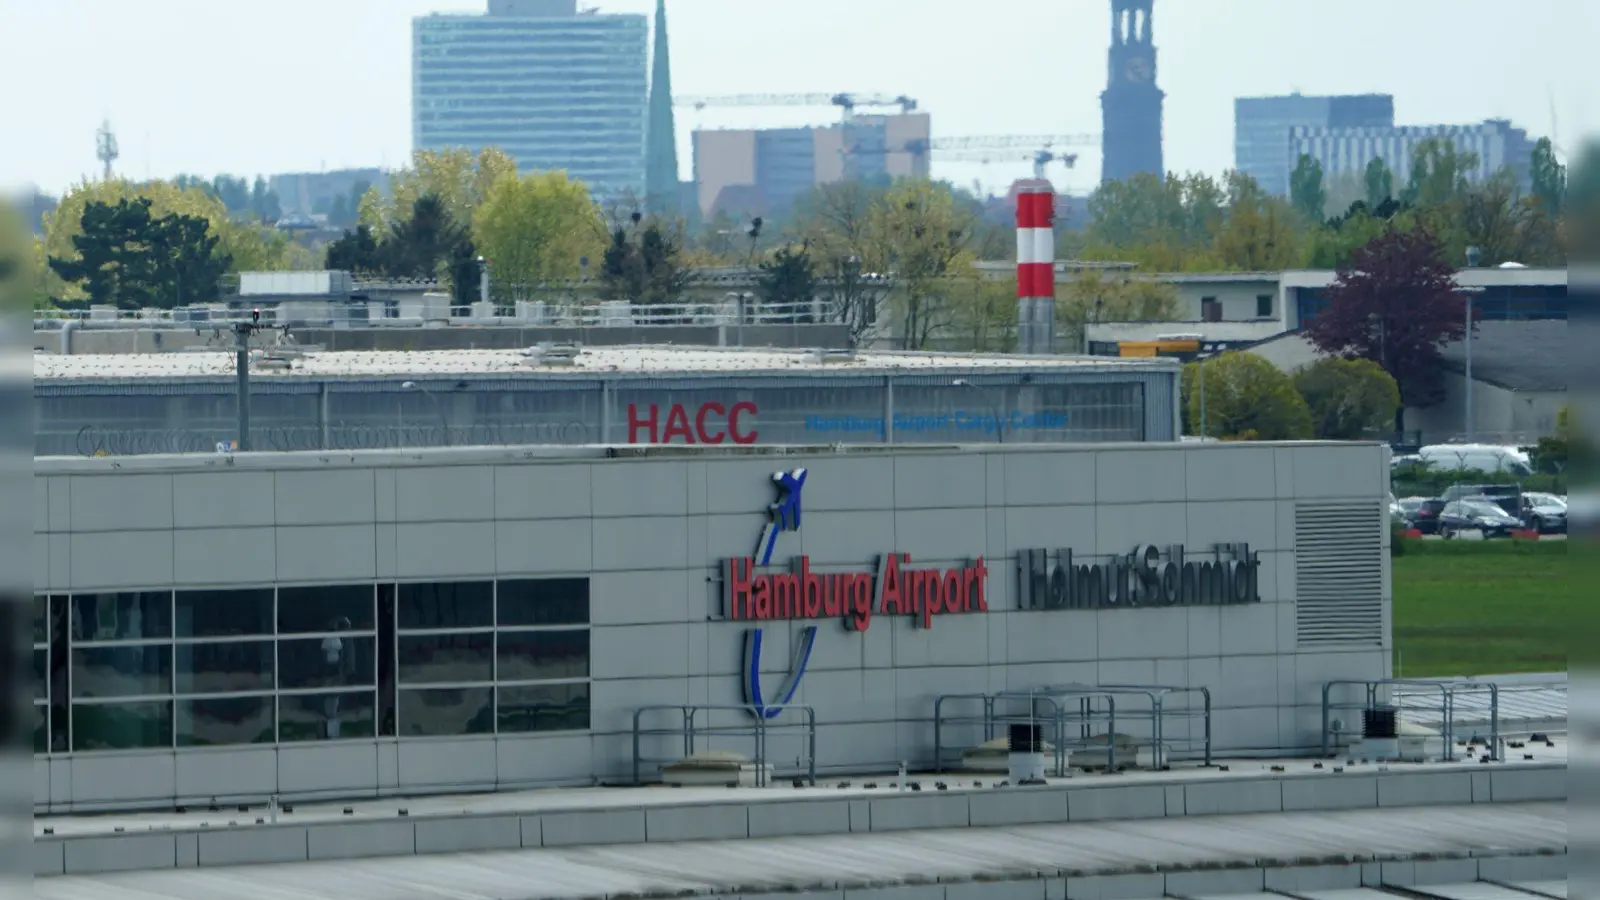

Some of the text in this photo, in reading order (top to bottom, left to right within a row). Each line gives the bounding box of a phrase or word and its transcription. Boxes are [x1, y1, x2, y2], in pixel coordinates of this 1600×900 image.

[628, 401, 759, 443] HACC
[805, 414, 885, 437] Hamburg
[729, 543, 1261, 632] Hamburg Airport Helmut Schmidt
